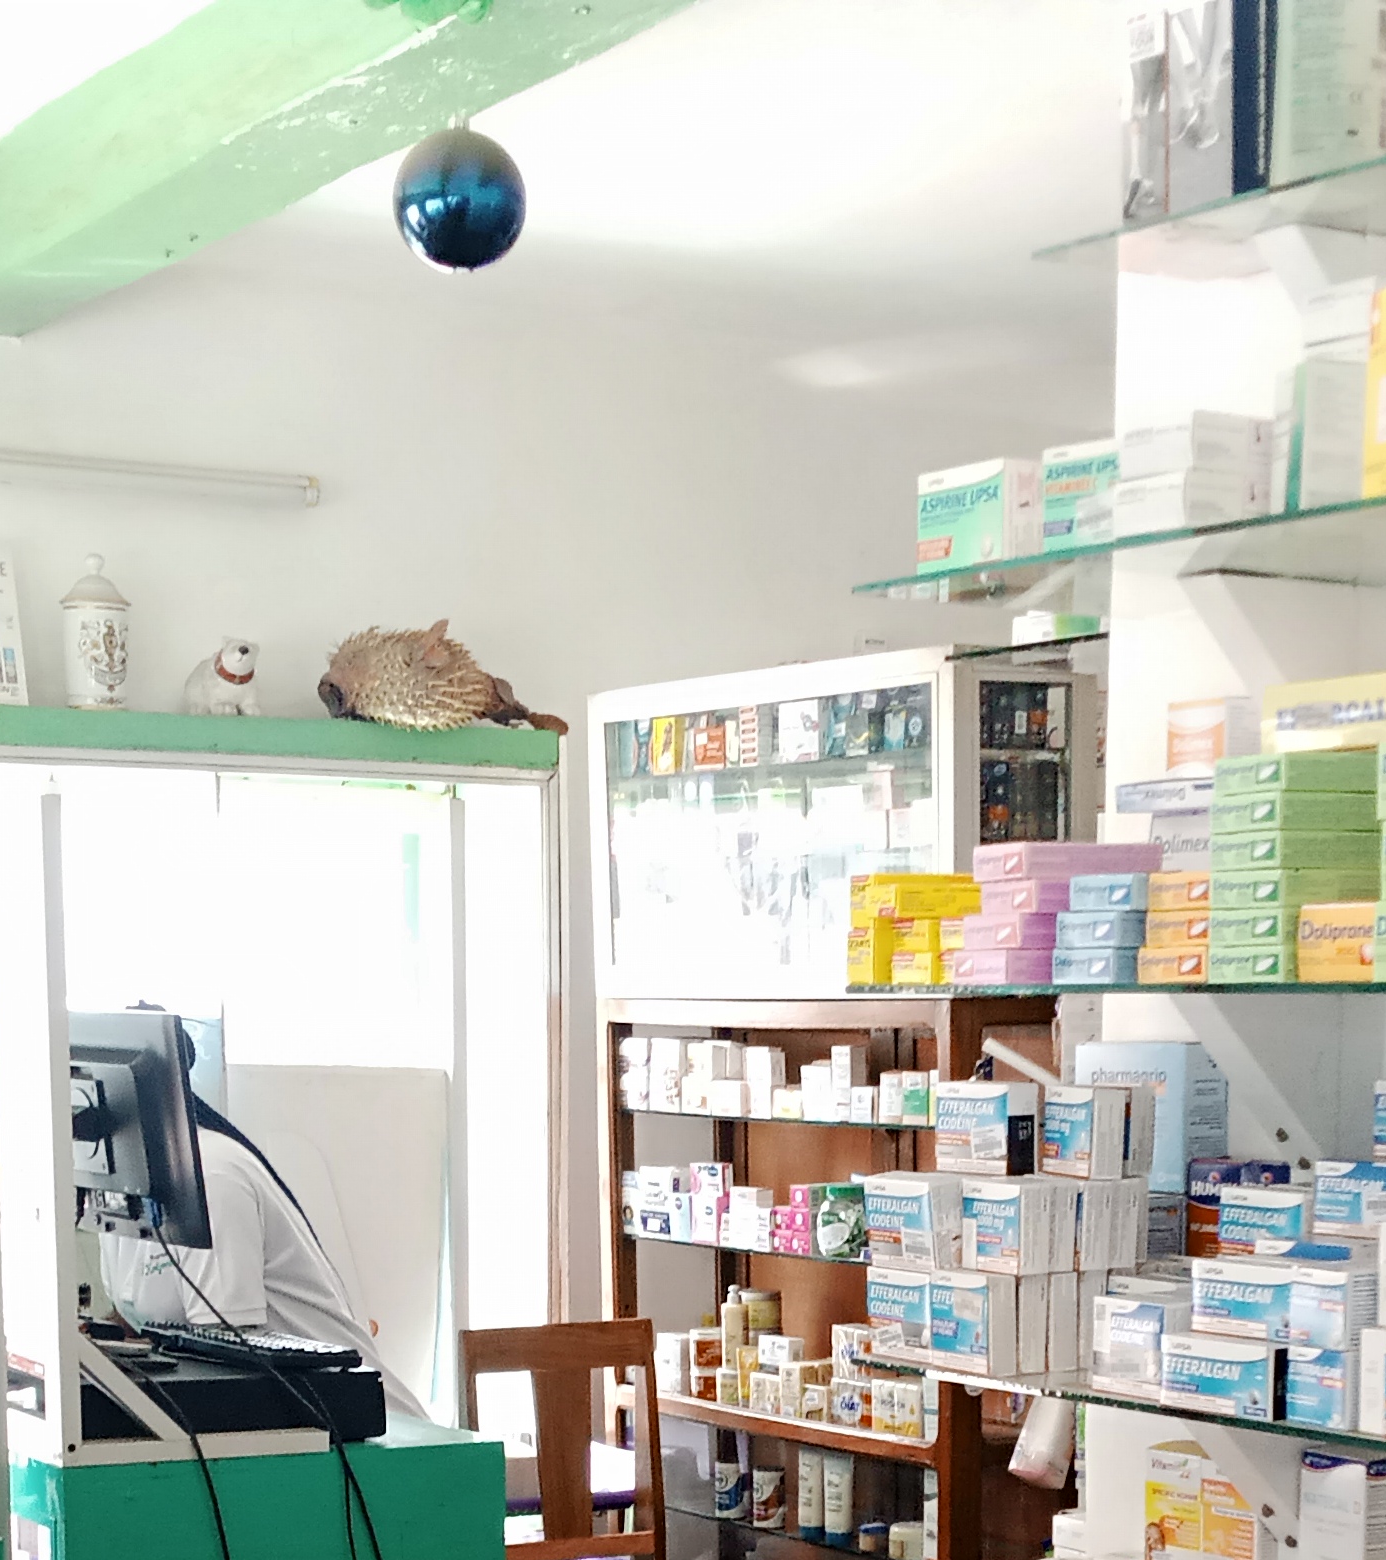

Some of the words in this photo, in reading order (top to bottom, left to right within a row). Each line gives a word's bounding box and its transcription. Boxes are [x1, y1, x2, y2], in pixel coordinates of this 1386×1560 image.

[939, 1100, 994, 1116] EFFERALGAN
[868, 1198, 920, 1214] EFFERALGAN
[973, 1200, 1016, 1216] EFFERALGAN
[870, 1286, 919, 1304] EFFERALGAN
[1196, 1281, 1274, 1303] EFFERALGAN
[1164, 1357, 1241, 1380] EFFERALGAN
